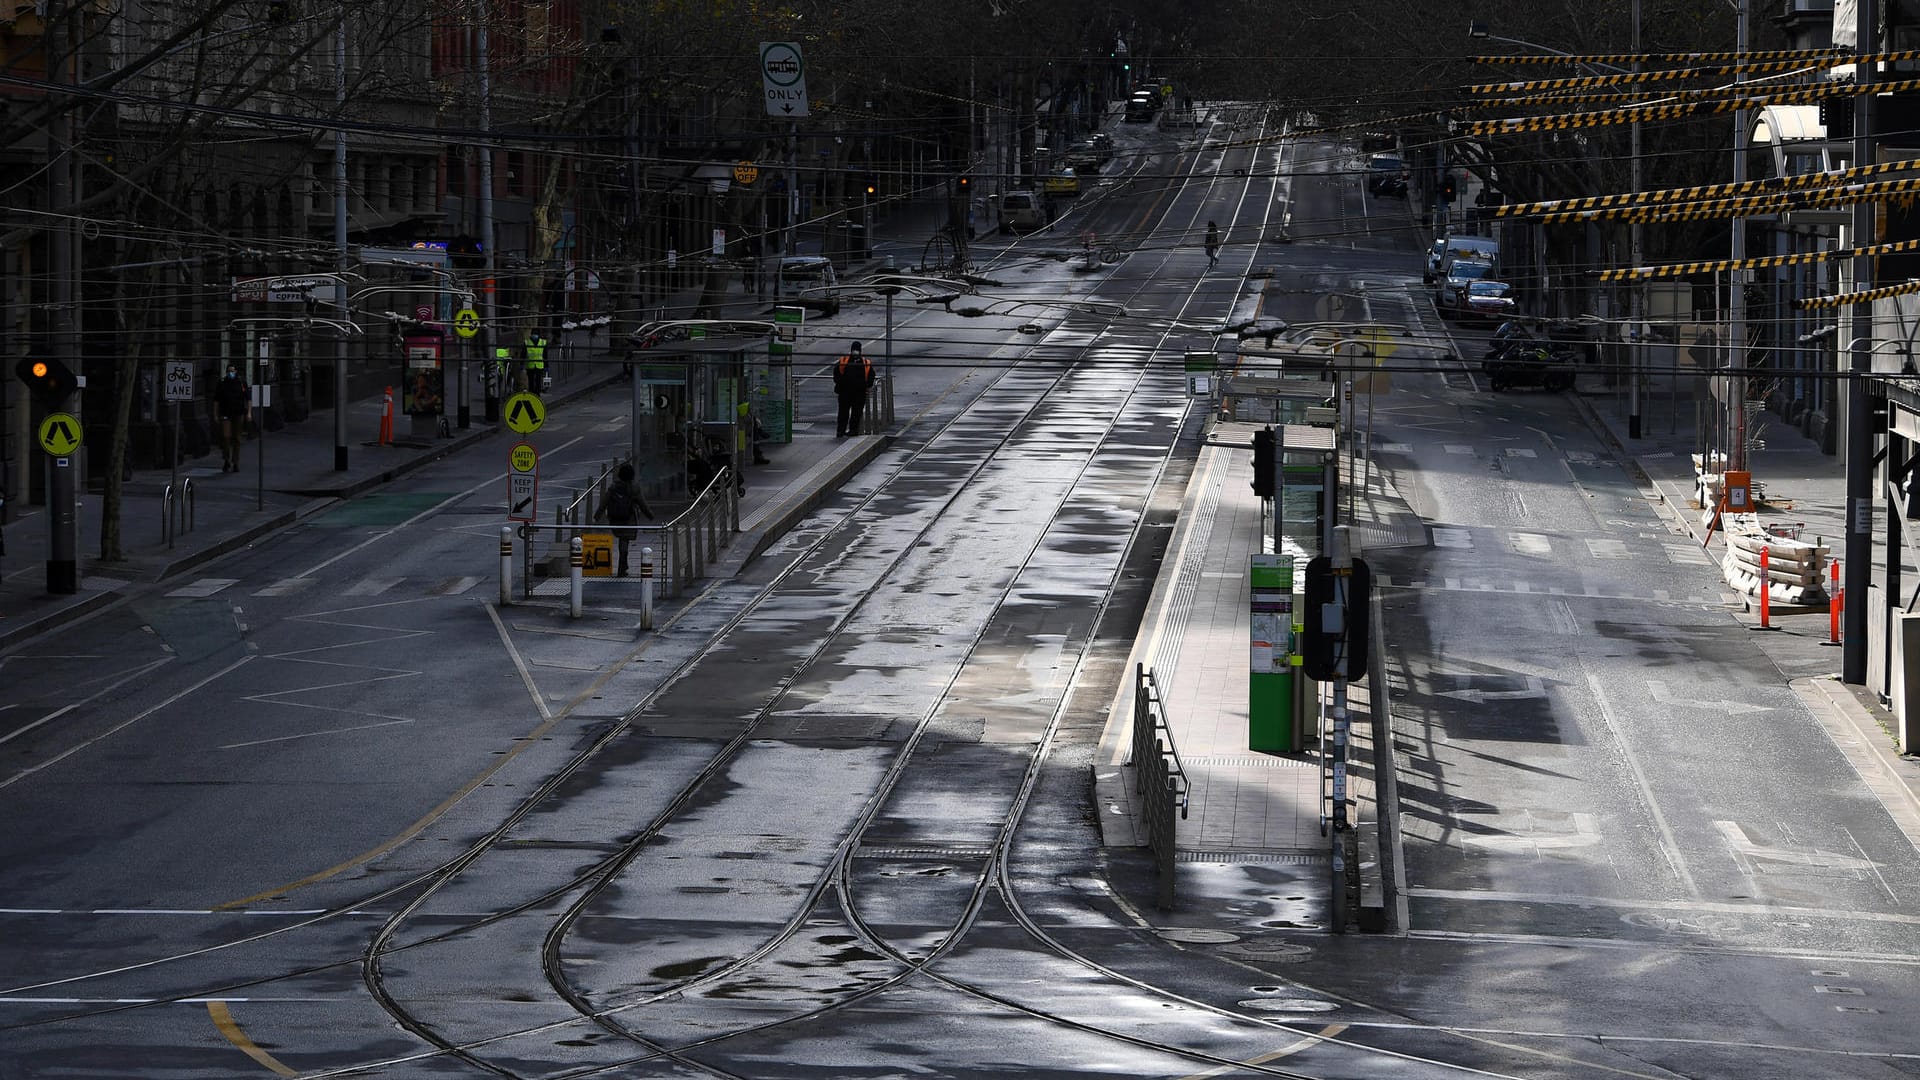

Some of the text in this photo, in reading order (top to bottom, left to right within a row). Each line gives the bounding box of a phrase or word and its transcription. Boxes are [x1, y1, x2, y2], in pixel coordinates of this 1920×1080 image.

[768, 89, 802, 100] ONLY
[738, 174, 754, 182] OFF
[166, 386, 191, 395] LANE
